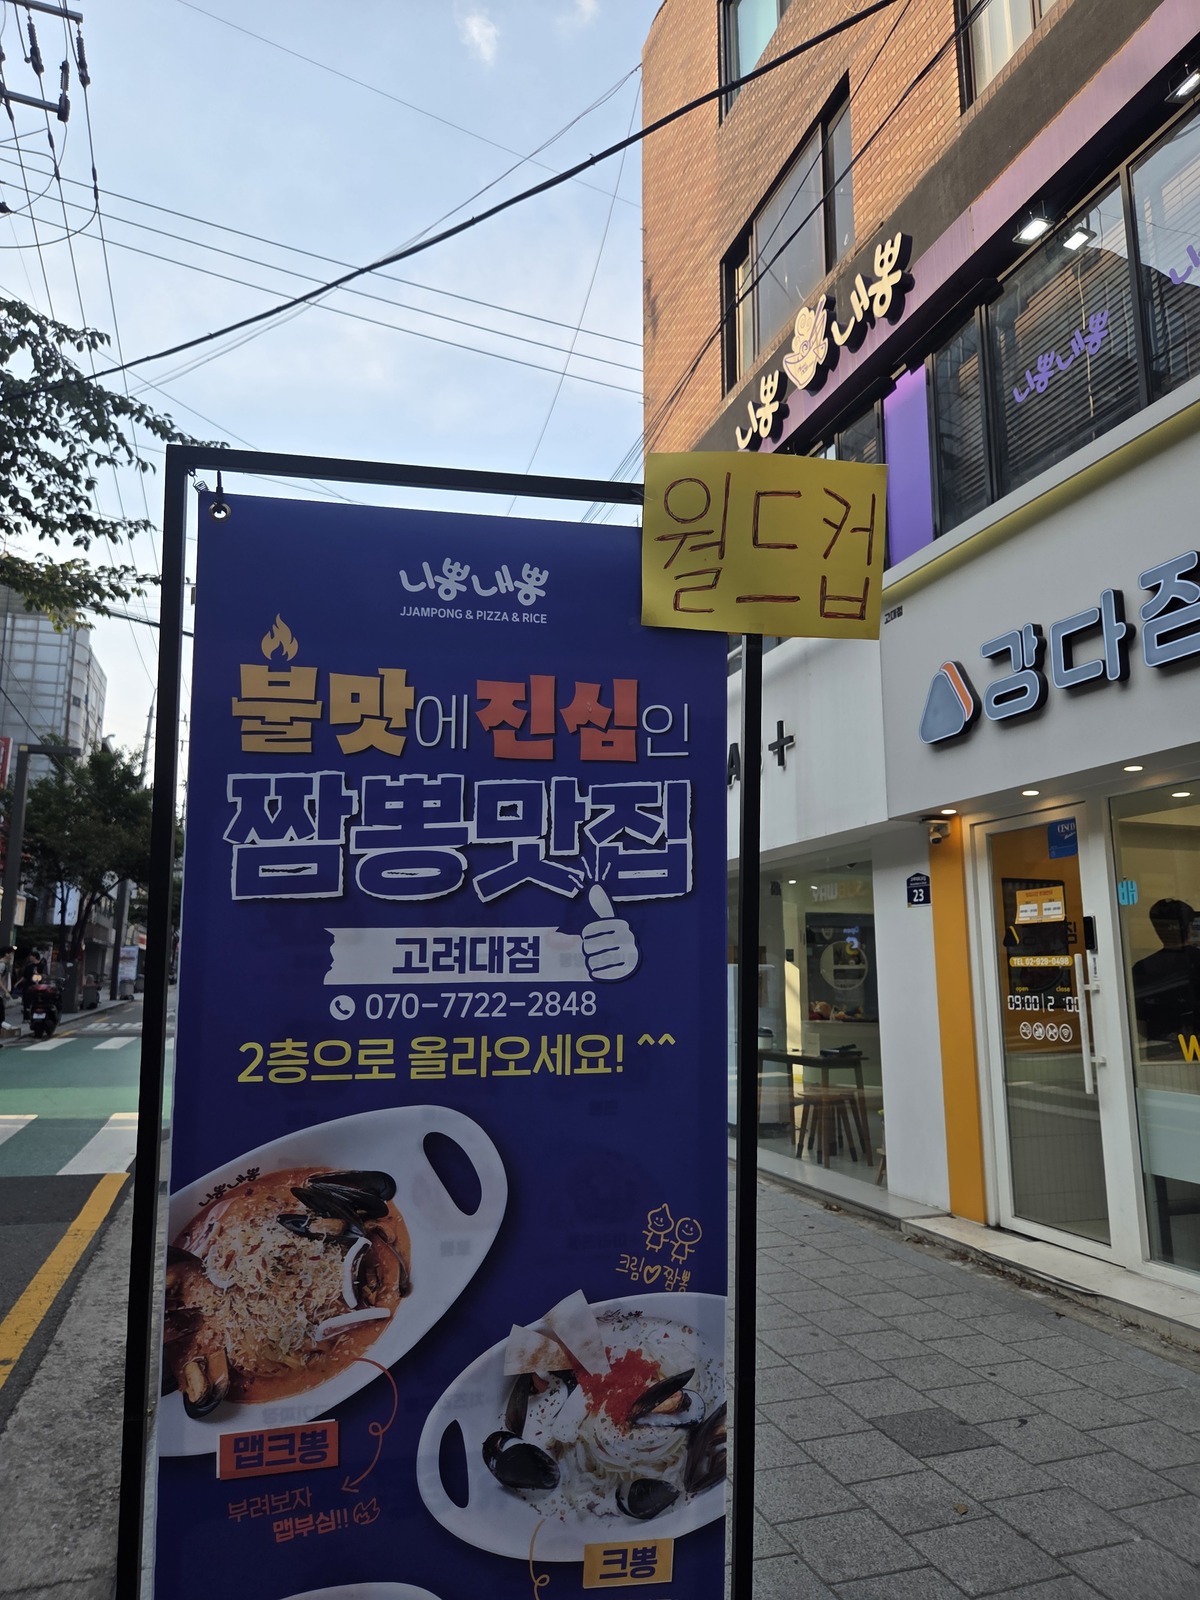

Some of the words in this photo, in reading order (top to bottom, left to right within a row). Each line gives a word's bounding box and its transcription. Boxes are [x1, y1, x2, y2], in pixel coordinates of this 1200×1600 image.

[1012, 309, 1109, 403] 니뽕내뽕
[654, 472, 876, 621] 월드컵
[399, 557, 549, 606] 니뽕내뽕
[400, 606, 462, 619] JJAMPONG
[465, 610, 474, 620] &
[476, 610, 509, 622] PIZZA
[511, 612, 520, 622] &
[522, 613, 547, 624] RICE
[913, 889, 924, 902] 23
[392, 936, 540, 975] 고려대점
[365, 991, 597, 1020] 070-7722-2848
[1008, 995, 1040, 1010] 09:00
[237, 1037, 396, 1083] 2층으로
[408, 1033, 624, 1080] 올라오세요!
[233, 1428, 329, 1470] 맵크뽕
[228, 1486, 312, 1522] 부려보자
[273, 1510, 348, 1543] 맵부심!!
[599, 1546, 657, 1579] 크뽕
